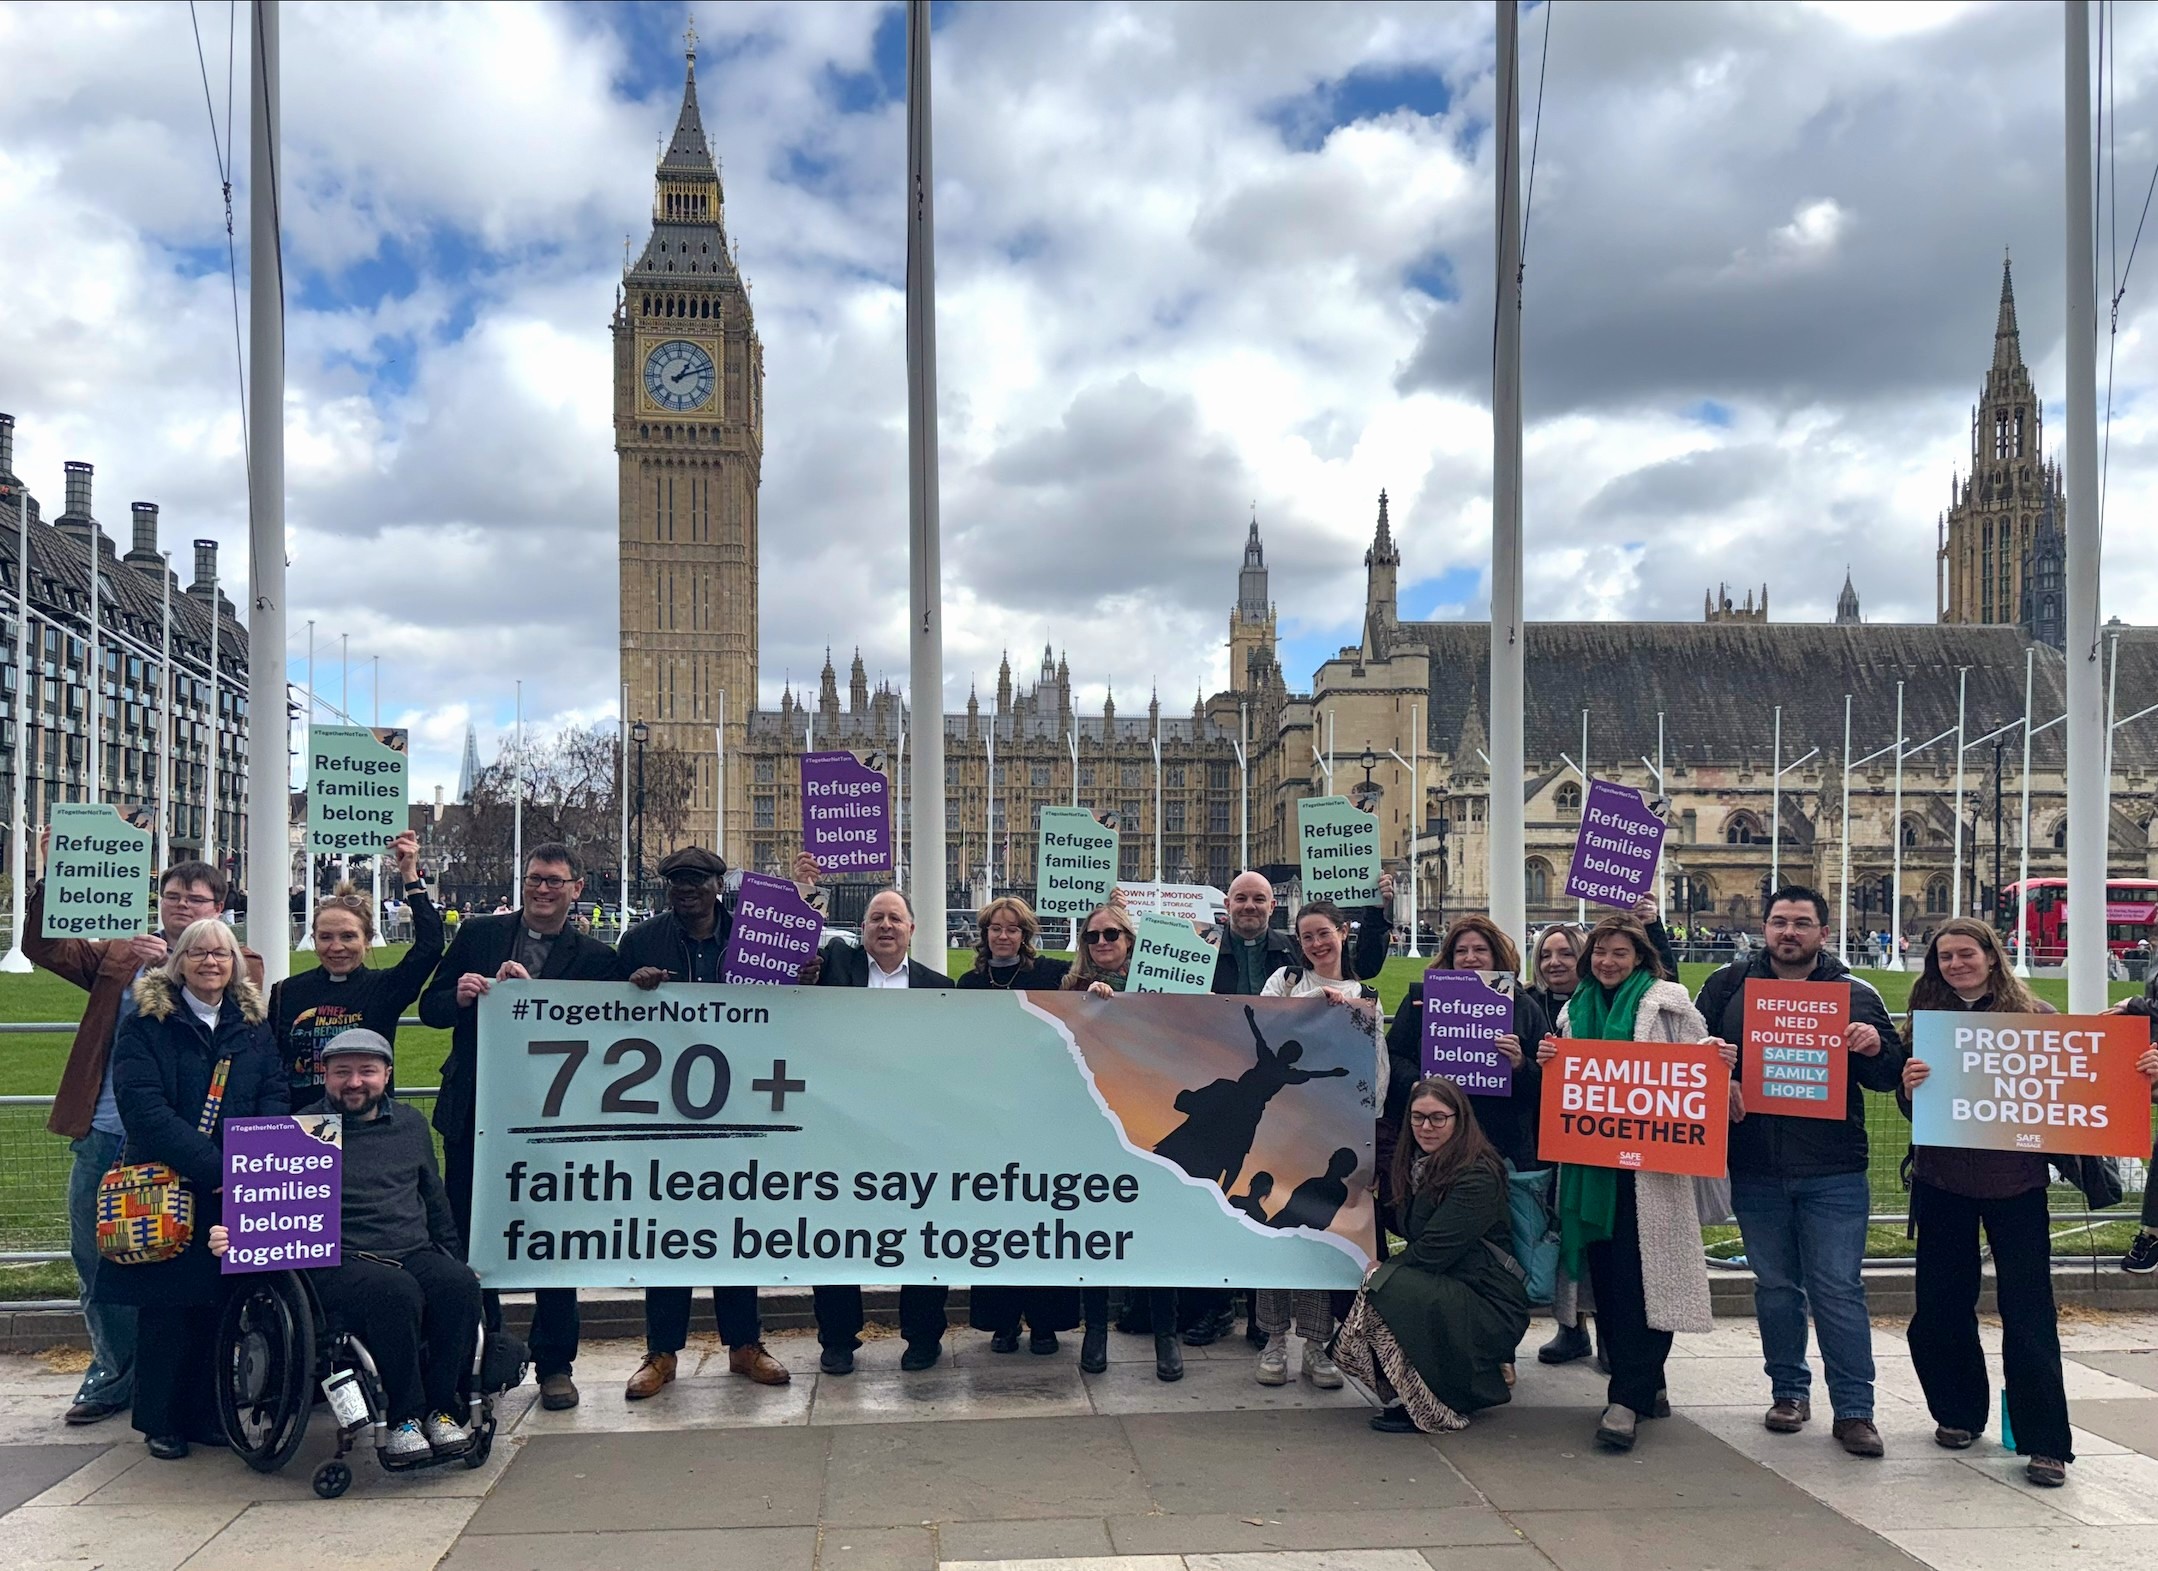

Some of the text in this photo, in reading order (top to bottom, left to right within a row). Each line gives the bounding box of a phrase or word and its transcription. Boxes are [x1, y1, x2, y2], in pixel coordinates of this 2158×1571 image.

[315, 754, 401, 775] Refugee
[316, 779, 399, 797] families
[807, 780, 882, 797] Refugee
[323, 804, 394, 825] belong
[809, 802, 881, 820] families
[1304, 822, 1373, 838] Refugee
[1588, 807, 1658, 837] Refugee
[55, 835, 144, 855] Refugee
[816, 826, 877, 844] belong
[1045, 832, 1113, 850] Refugee
[1307, 843, 1373, 859] families
[1585, 831, 1652, 860] families
[55, 861, 140, 878] families
[1045, 854, 1111, 870] families
[1583, 853, 1642, 884] belong
[1313, 865, 1369, 880] belong
[1049, 875, 1105, 894] belong
[1123, 889, 1145, 897] OWN
[1306, 885, 1378, 902] together
[59, 887, 133, 907] belong
[1040, 897, 1103, 913] togethe
[48, 913, 142, 933] together
[741, 900, 817, 930] Refugee
[1177, 911, 1196, 919] 1200
[738, 924, 810, 953] families
[1140, 938, 1211, 964] Refugee
[737, 947, 800, 977] belong
[1137, 961, 1205, 986] families
[511, 999, 770, 1026] #TogetherNotTorn
[1428, 998, 1507, 1018] Refugee
[1756, 998, 1838, 1014] REFUGEES
[1429, 1022, 1504, 1040] families
[1775, 1016, 1818, 1029] NEED
[1751, 1030, 1842, 1048] ROUTES TO
[1955, 1027, 2106, 1054] PROTECT
[1434, 1045, 1498, 1067] belong
[1764, 1048, 1826, 1063] SAFETY
[1564, 1056, 1707, 1088] FAMILIES
[1765, 1065, 1826, 1081] FAMILY
[1962, 1052, 2097, 1083] PEOPLE,
[527, 1037, 806, 1120] 720+
[1994, 1076, 2065, 1101] NOT
[1771, 1084, 1815, 1098] HOPE
[1562, 1083, 1706, 1120] BELONG
[1952, 1098, 2109, 1128] BORDERS
[231, 1124, 295, 1132] #TogetherNotTorn
[1560, 1113, 1706, 1146] TOGETHER
[2016, 1133, 2041, 1142] SAFE
[231, 1153, 334, 1174] Refugee
[1619, 1151, 1641, 1160] SAFE
[232, 1180, 331, 1203] families
[505, 1159, 1139, 1212] faith leaders say refugee
[239, 1211, 325, 1233] belong
[503, 1217, 1133, 1268] families belong together
[227, 1240, 335, 1266] together
